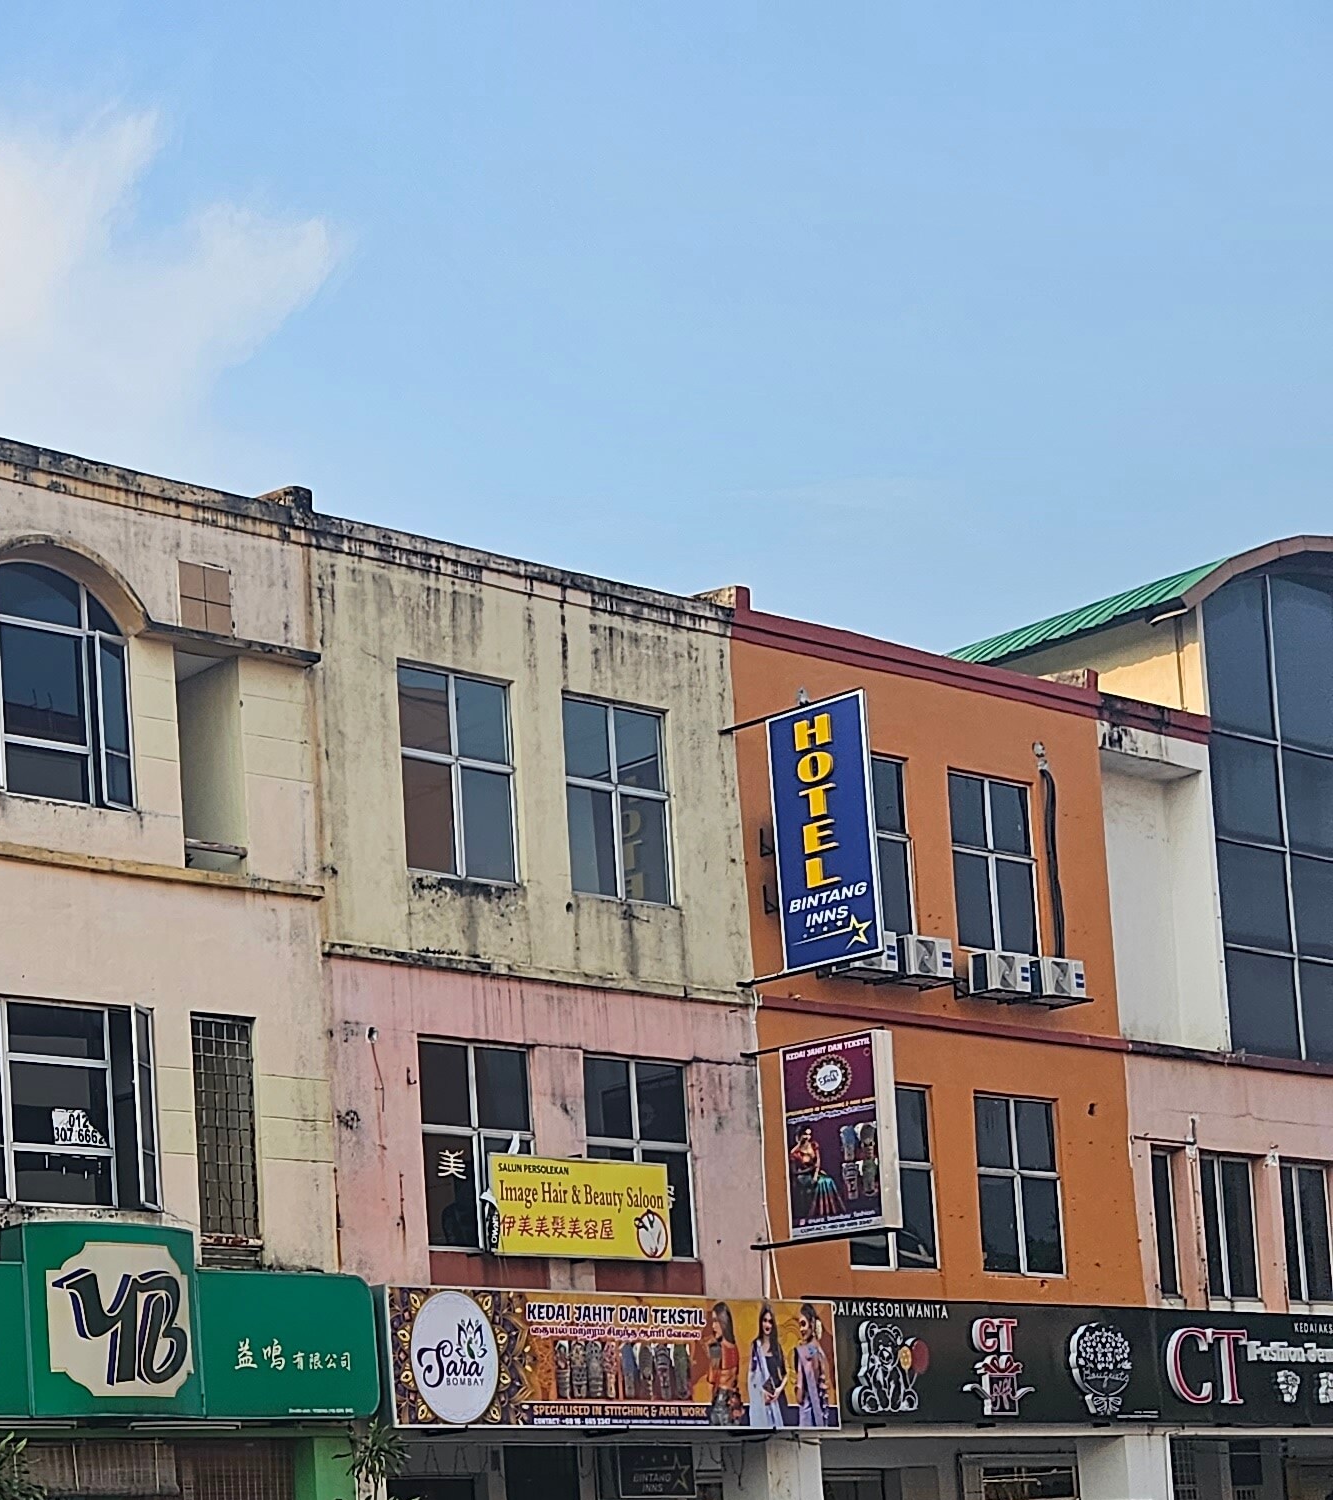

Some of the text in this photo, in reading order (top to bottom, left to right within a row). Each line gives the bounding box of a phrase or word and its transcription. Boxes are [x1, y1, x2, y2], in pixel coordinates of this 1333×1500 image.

[793, 712, 842, 890] HOTEL
[788, 881, 868, 914] BINTANG
[805, 905, 849, 928] INNS
[497, 1162, 570, 1176] SALUN PERSOLEKAN
[499, 1179, 539, 1209] Image
[540, 1181, 568, 1204] Hair
[571, 1186, 581, 1204] &
[583, 1183, 624, 1213] Beauty
[626, 1186, 664, 1210] Saloon
[51, 1267, 188, 1387] YB
[526, 1303, 706, 1326] KEDAI JAHIT DAN TEKSTIL
[832, 1302, 950, 1319] DAI AKSESORI WANITA
[971, 1317, 1019, 1353] CT
[417, 1339, 485, 1389] Sara
[1165, 1326, 1248, 1404] CT
[445, 1377, 485, 1387] BOMBAY
[532, 1404, 591, 1417] SPECIALISED
[591, 1405, 603, 1416] IN
[604, 1405, 650, 1418] STITCHING
[650, 1406, 658, 1417] &
[680, 1406, 708, 1418] WORK
